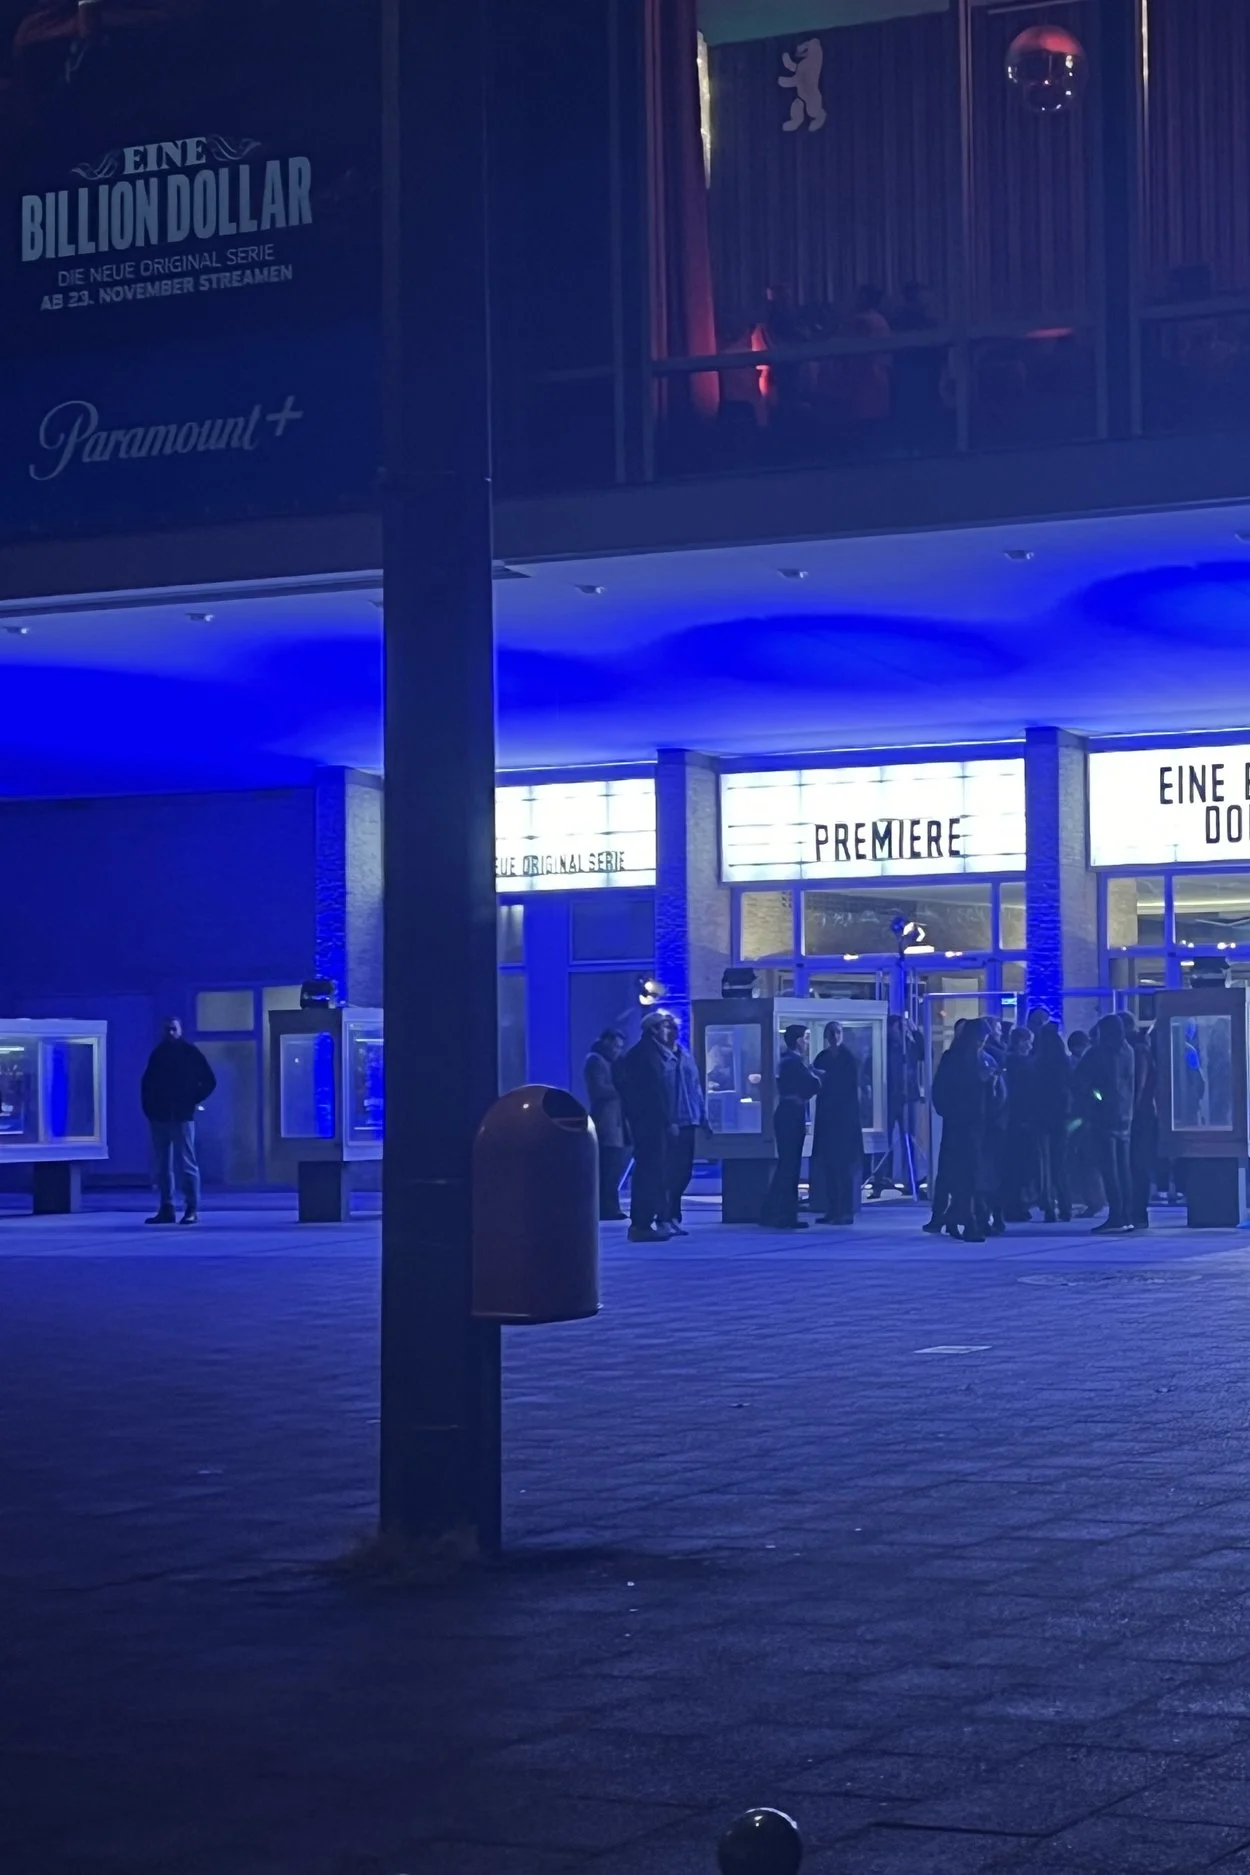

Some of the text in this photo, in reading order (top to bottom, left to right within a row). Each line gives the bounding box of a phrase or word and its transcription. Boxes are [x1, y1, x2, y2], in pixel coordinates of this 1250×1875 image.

[122, 137, 207, 175] EINE
[21, 156, 313, 262] BILLION DOLLAR
[58, 244, 275, 287] DIE NEUE ORIGINAL SERIE
[40, 265, 293, 311] AB 23. NOVEMBER STREAMEN
[1159, 763, 1225, 805] EINE
[815, 817, 962, 862] PREMIERE
[523, 854, 585, 876] ORIGINAL
[589, 850, 625, 873] SERIE
